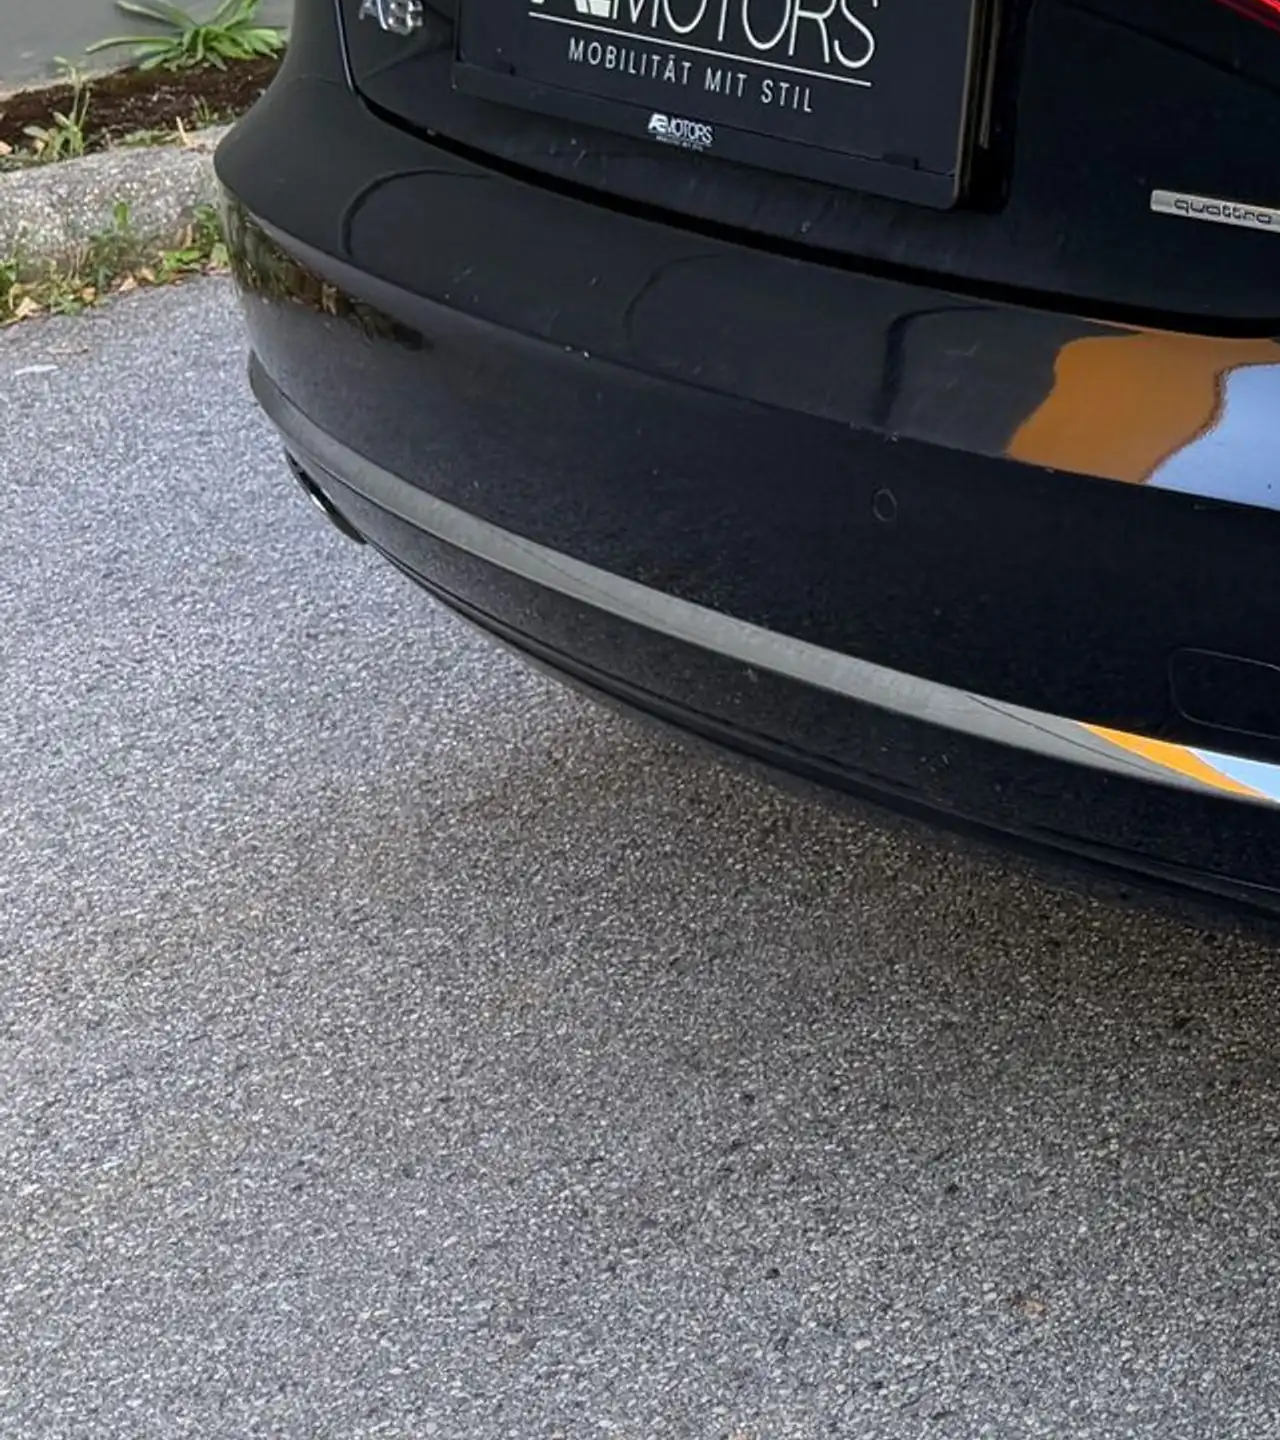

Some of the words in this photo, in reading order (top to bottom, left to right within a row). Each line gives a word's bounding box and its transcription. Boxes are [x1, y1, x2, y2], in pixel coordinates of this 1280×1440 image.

[568, 37, 693, 85] MOBILITÄT
[705, 67, 748, 97] MIT
[761, 79, 813, 112] STIL
[1174, 198, 1272, 224] quattro
